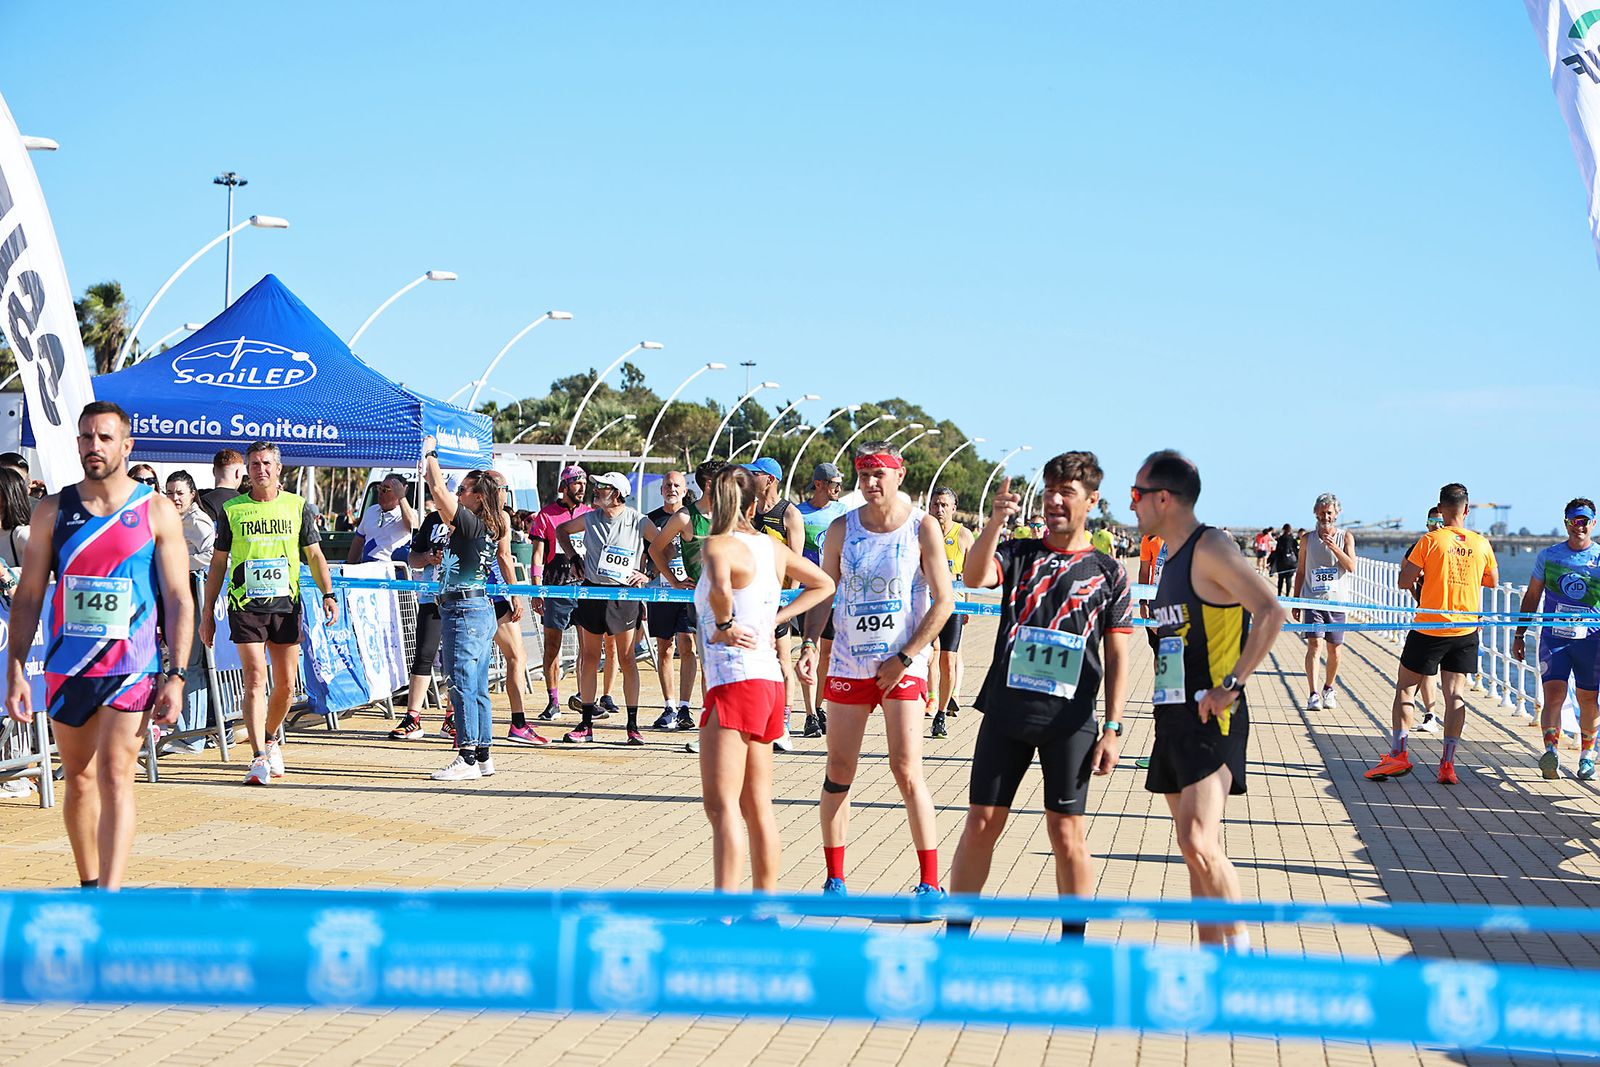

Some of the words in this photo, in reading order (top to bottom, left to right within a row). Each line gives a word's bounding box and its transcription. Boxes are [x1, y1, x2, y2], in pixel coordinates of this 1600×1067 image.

[174, 367, 305, 386] SaniLEP
[129, 413, 221, 436] istencia
[230, 414, 338, 440] Sanitaria
[605, 553, 630, 567] 608
[253, 568, 282, 581] 146
[1315, 573, 1334, 582] 385
[1571, 582, 1584, 591] JD
[74, 592, 118, 612] 148
[856, 614, 895, 633] 494
[1025, 644, 1070, 668] 111
